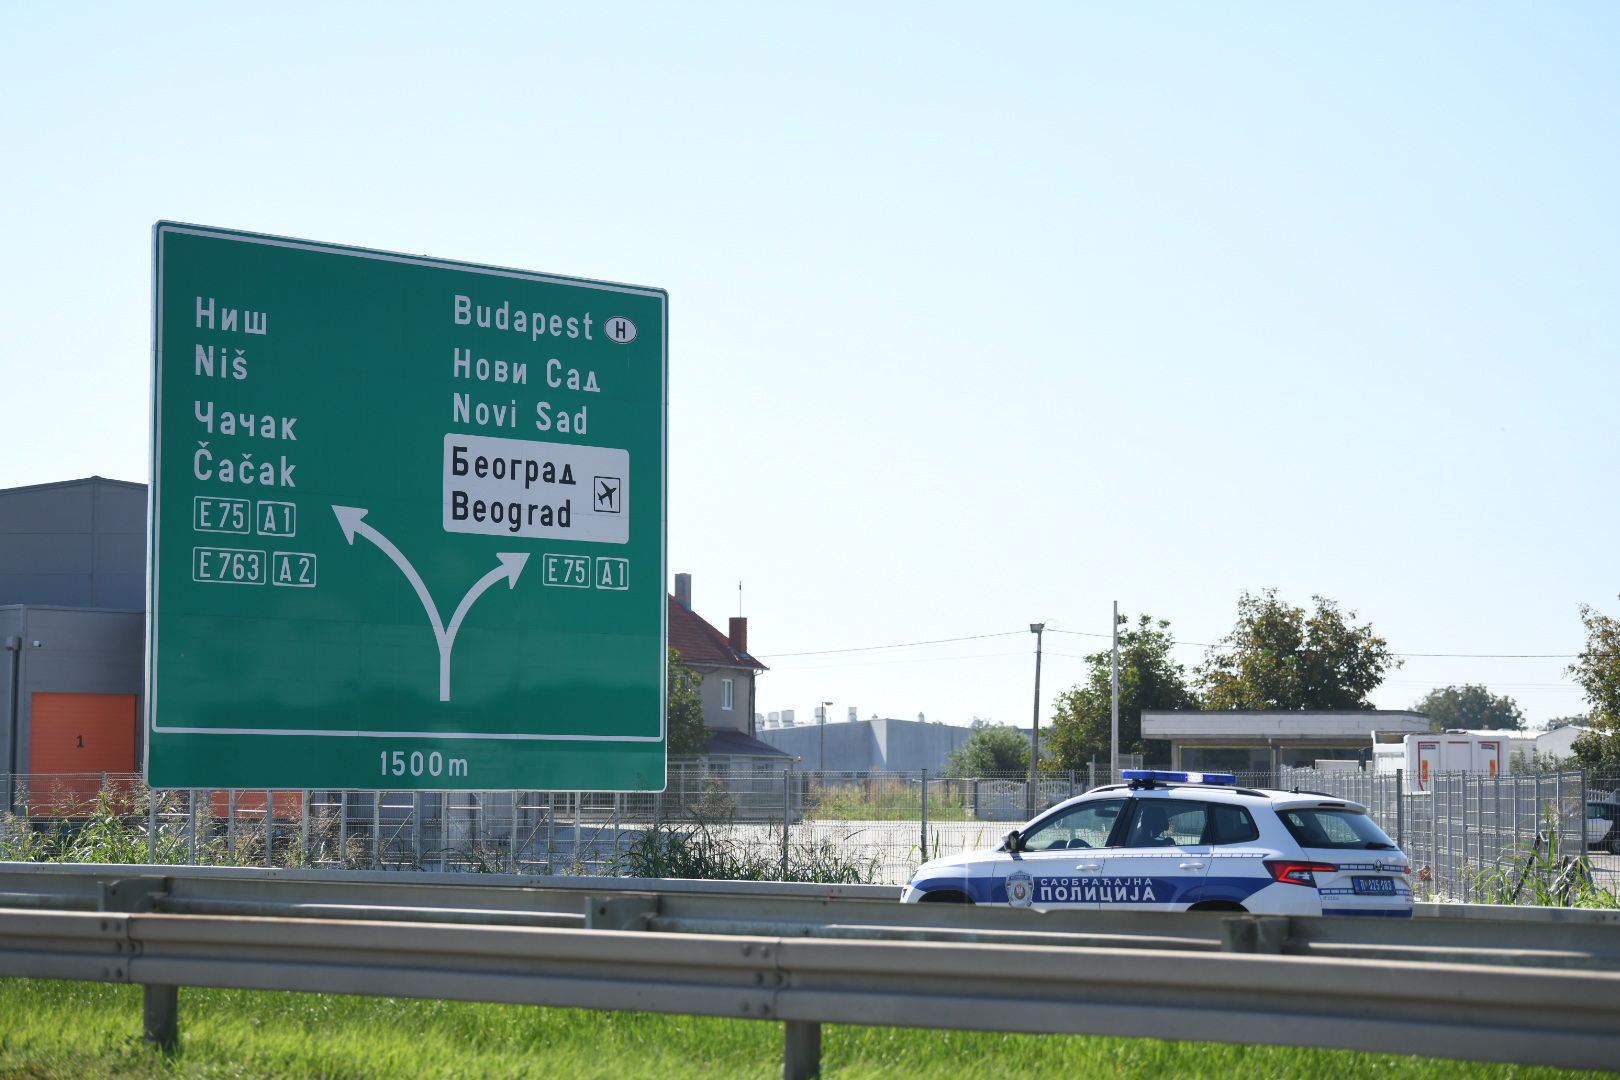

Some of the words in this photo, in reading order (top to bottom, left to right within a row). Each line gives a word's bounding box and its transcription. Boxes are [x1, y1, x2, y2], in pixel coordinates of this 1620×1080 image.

[196, 296, 267, 335] Ниш
[454, 295, 593, 342] Budapest
[195, 344, 248, 380] Niš
[453, 348, 527, 385] Нови
[546, 359, 601, 393] Сад
[194, 400, 297, 440] Чачак
[453, 393, 516, 428] Novi
[535, 402, 587, 435] Sad
[194, 441, 295, 487] Čačak
[453, 446, 576, 489] Београд
[452, 491, 571, 532] Beograd
[76, 735, 85, 748] 1
[1040, 878, 1153, 886] САОБРАЋАЈНА
[1040, 887, 1156, 903] ПОЛИЦИЈА
